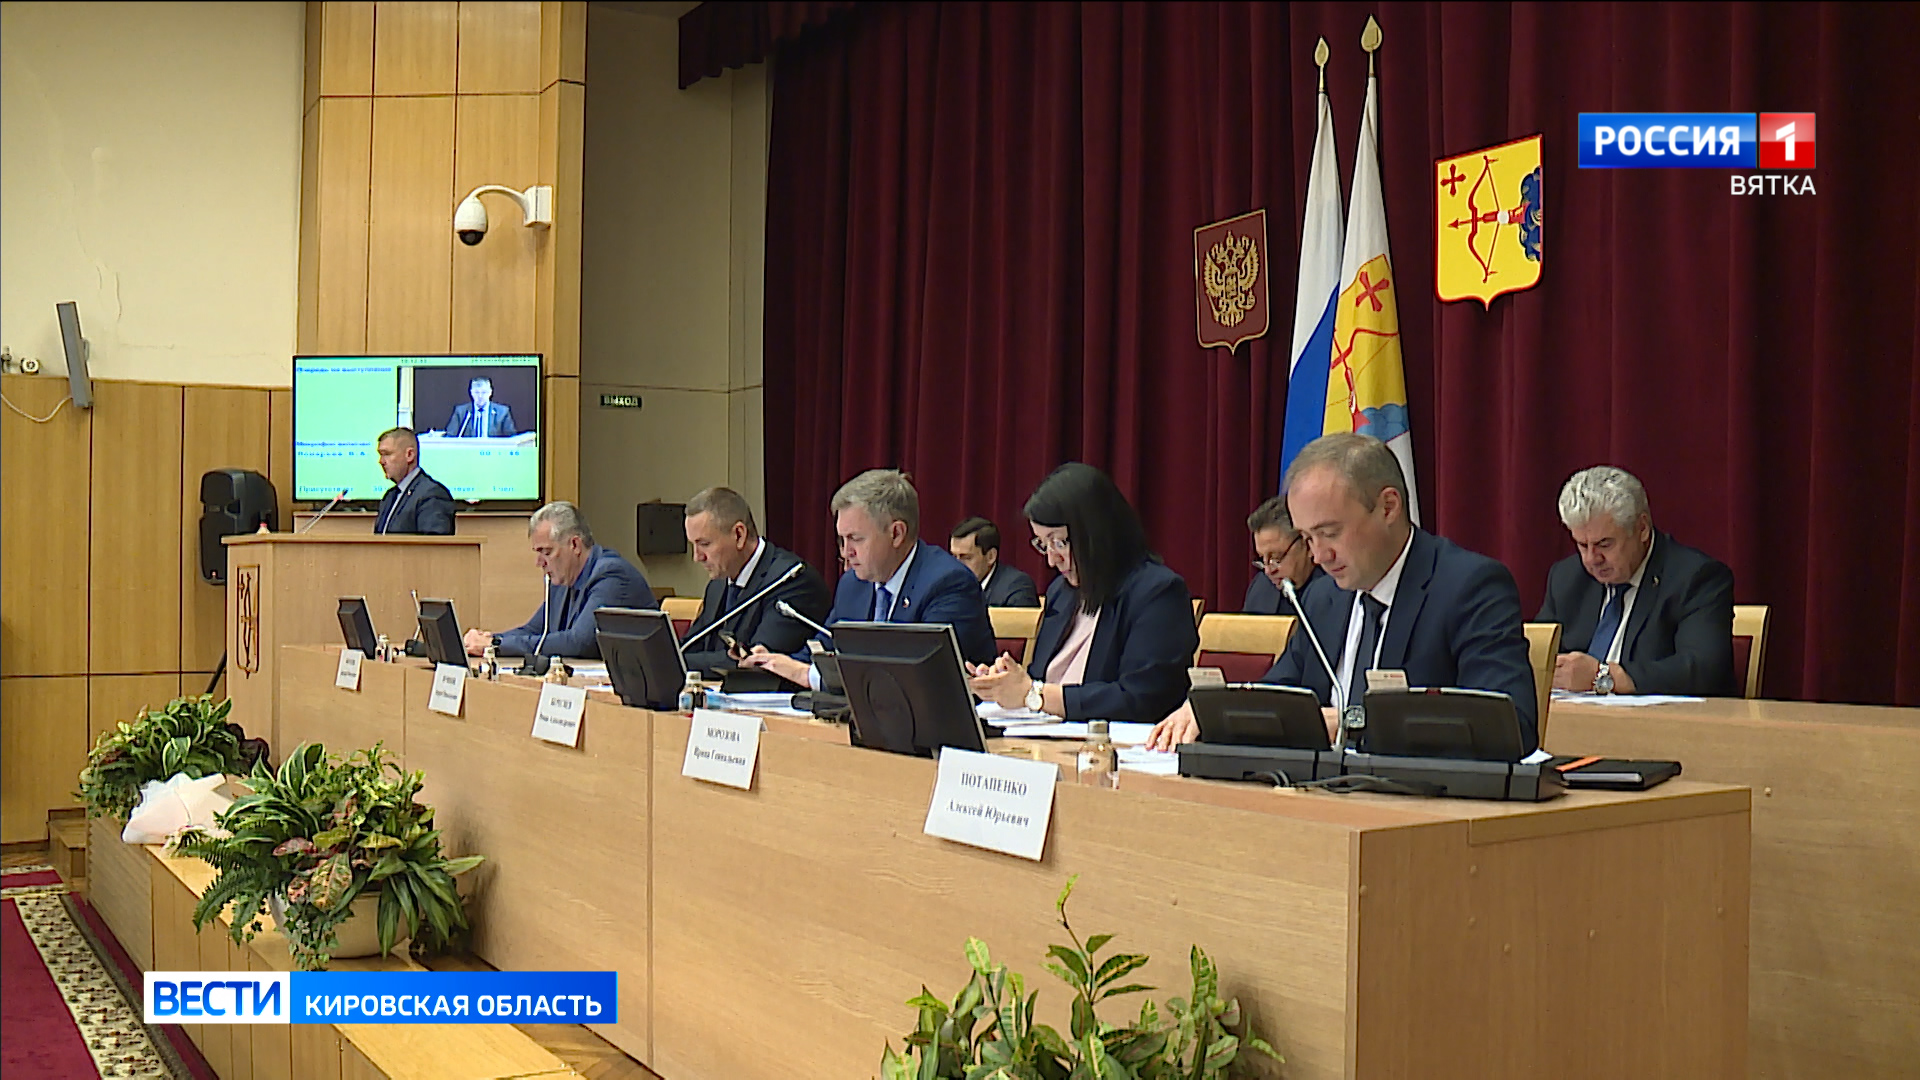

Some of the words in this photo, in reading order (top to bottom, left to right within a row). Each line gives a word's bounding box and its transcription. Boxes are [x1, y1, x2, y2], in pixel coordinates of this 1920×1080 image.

[960, 770, 1028, 797] ПОТАПЕНКО
[946, 798, 983, 818] Алексей
[984, 804, 1030, 828] Юрьевич
